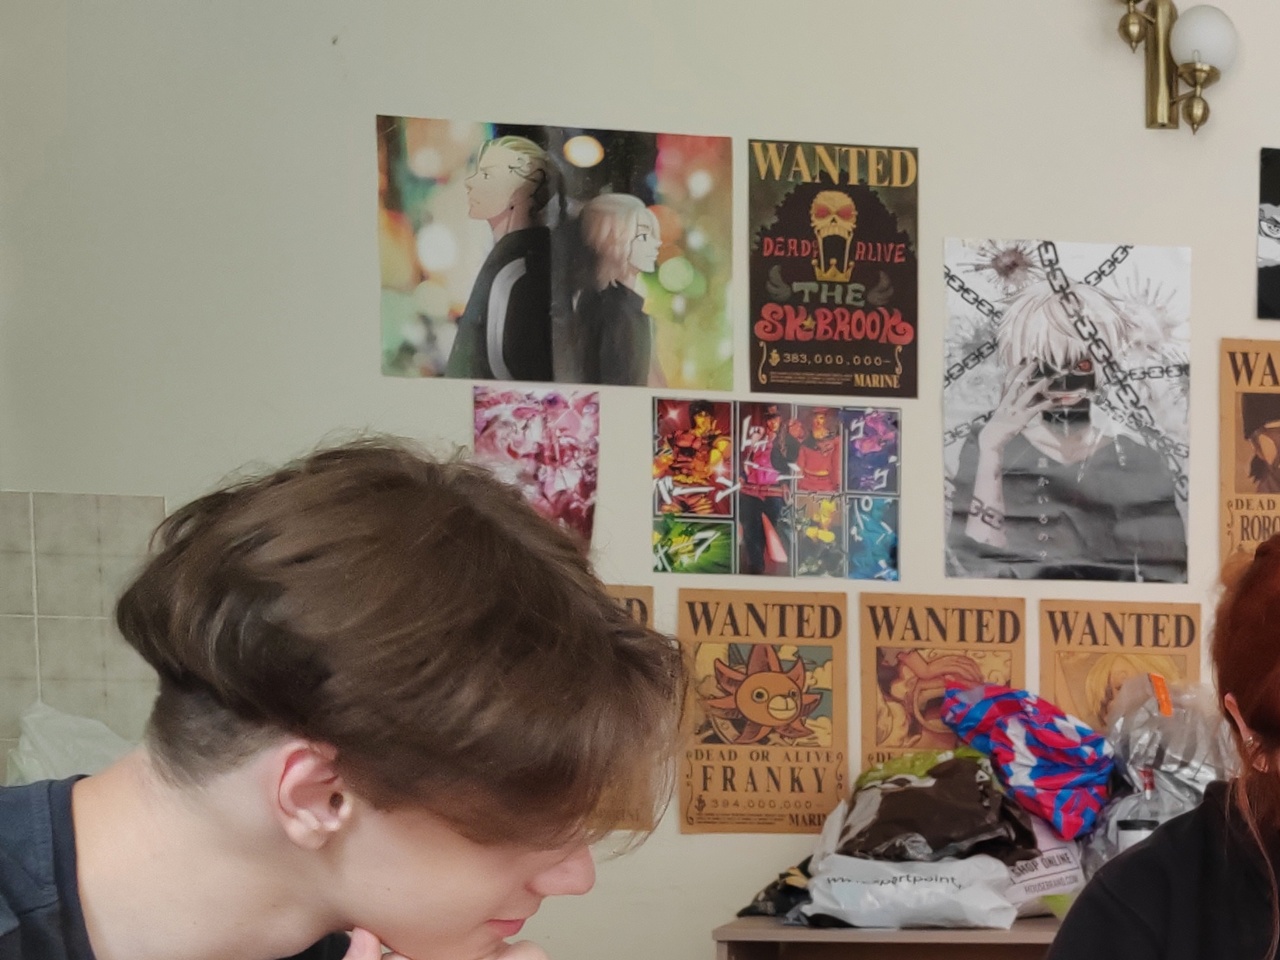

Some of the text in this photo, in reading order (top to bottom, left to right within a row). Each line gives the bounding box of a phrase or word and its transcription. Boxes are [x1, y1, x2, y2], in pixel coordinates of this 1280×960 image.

[752, 142, 917, 188] WANTED
[763, 237, 811, 257] DEAD
[855, 241, 906, 263] ALIVE
[792, 281, 866, 307] THE
[854, 373, 900, 389] MARINE
[1234, 498, 1276, 511] DEAD
[685, 600, 843, 640] WANTED
[867, 605, 1022, 645] WANTED
[1046, 610, 1197, 649] WANTED
[694, 748, 834, 764] DEAD OR ALIVE
[701, 765, 828, 794] FRANKY
[1041, 852, 1072, 869] ONLINE
